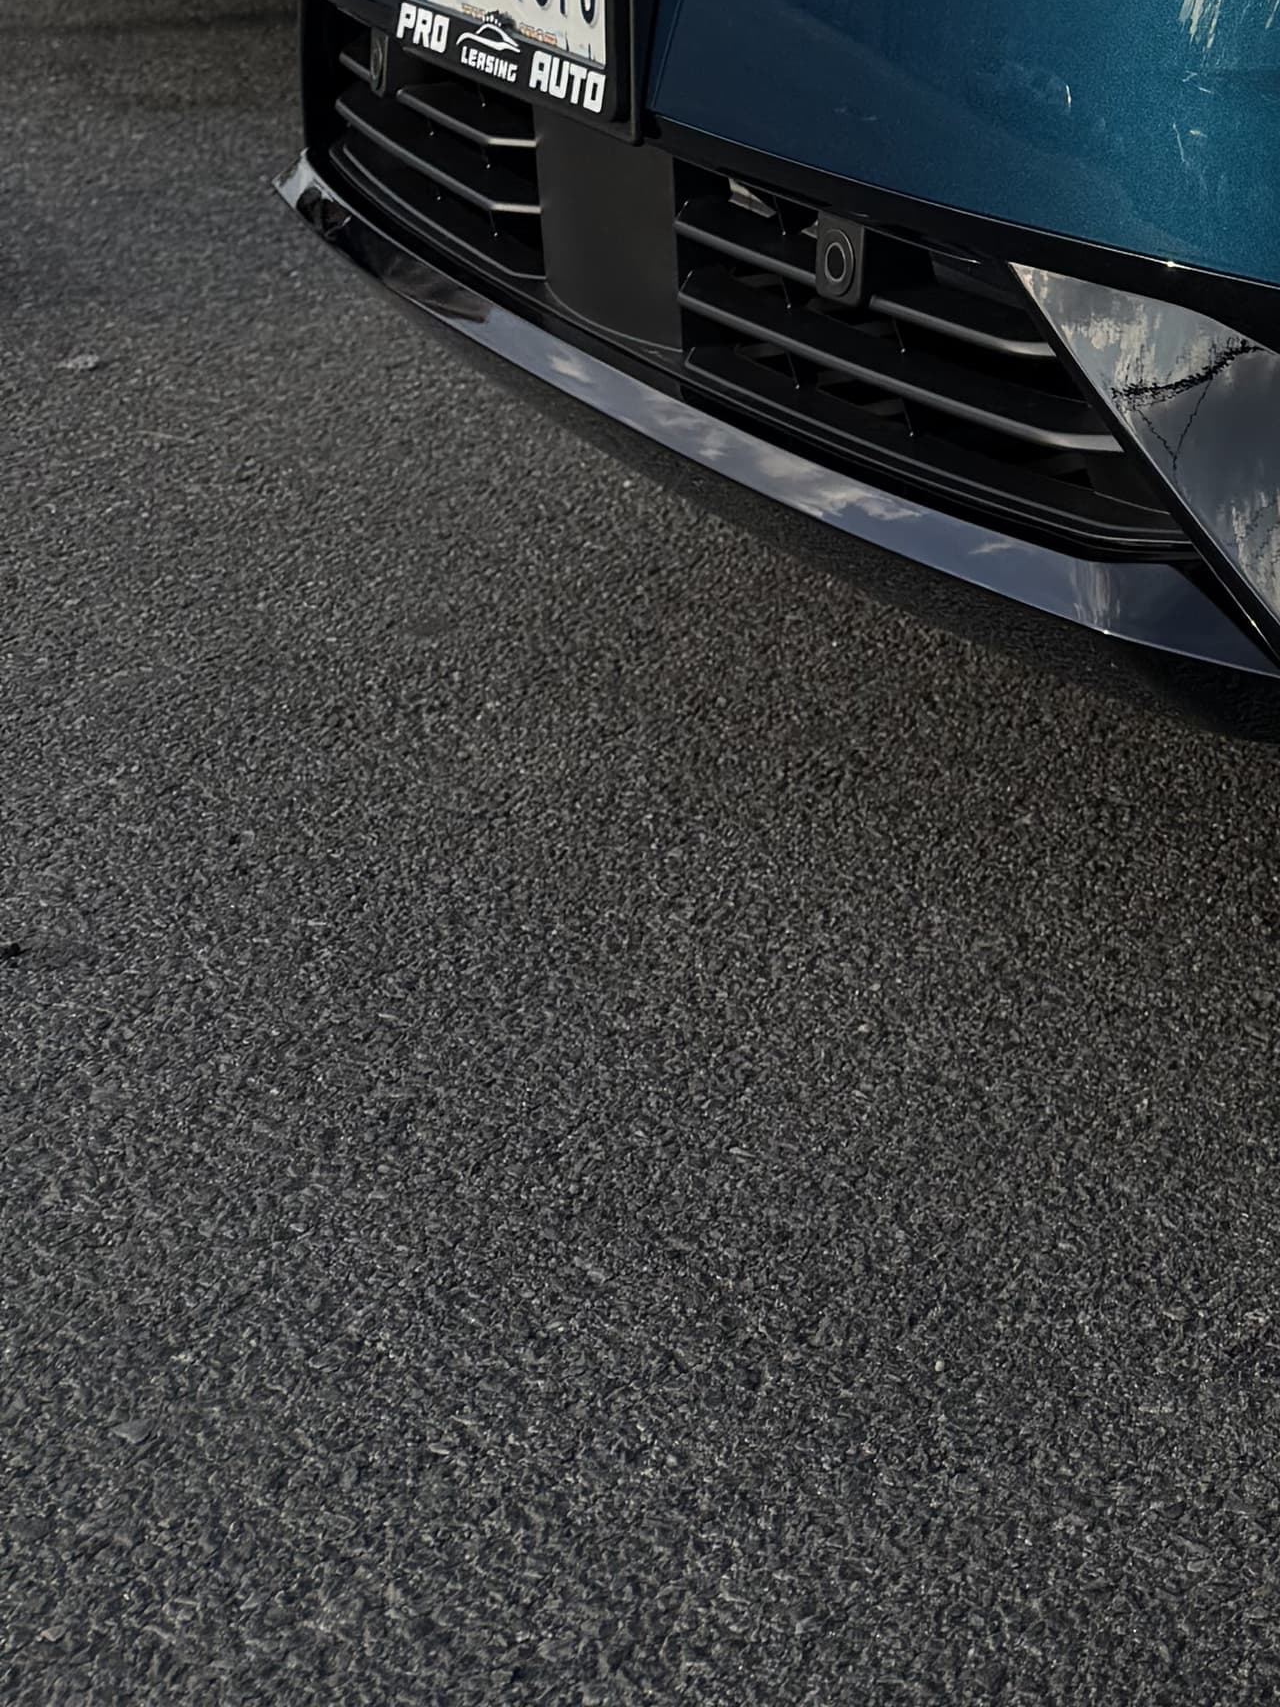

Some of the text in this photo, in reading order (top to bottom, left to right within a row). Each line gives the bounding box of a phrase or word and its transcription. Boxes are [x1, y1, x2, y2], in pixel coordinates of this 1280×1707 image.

[396, 2, 450, 53] PRO
[529, 50, 606, 114] AUTO
[459, 45, 518, 83] LEASING
